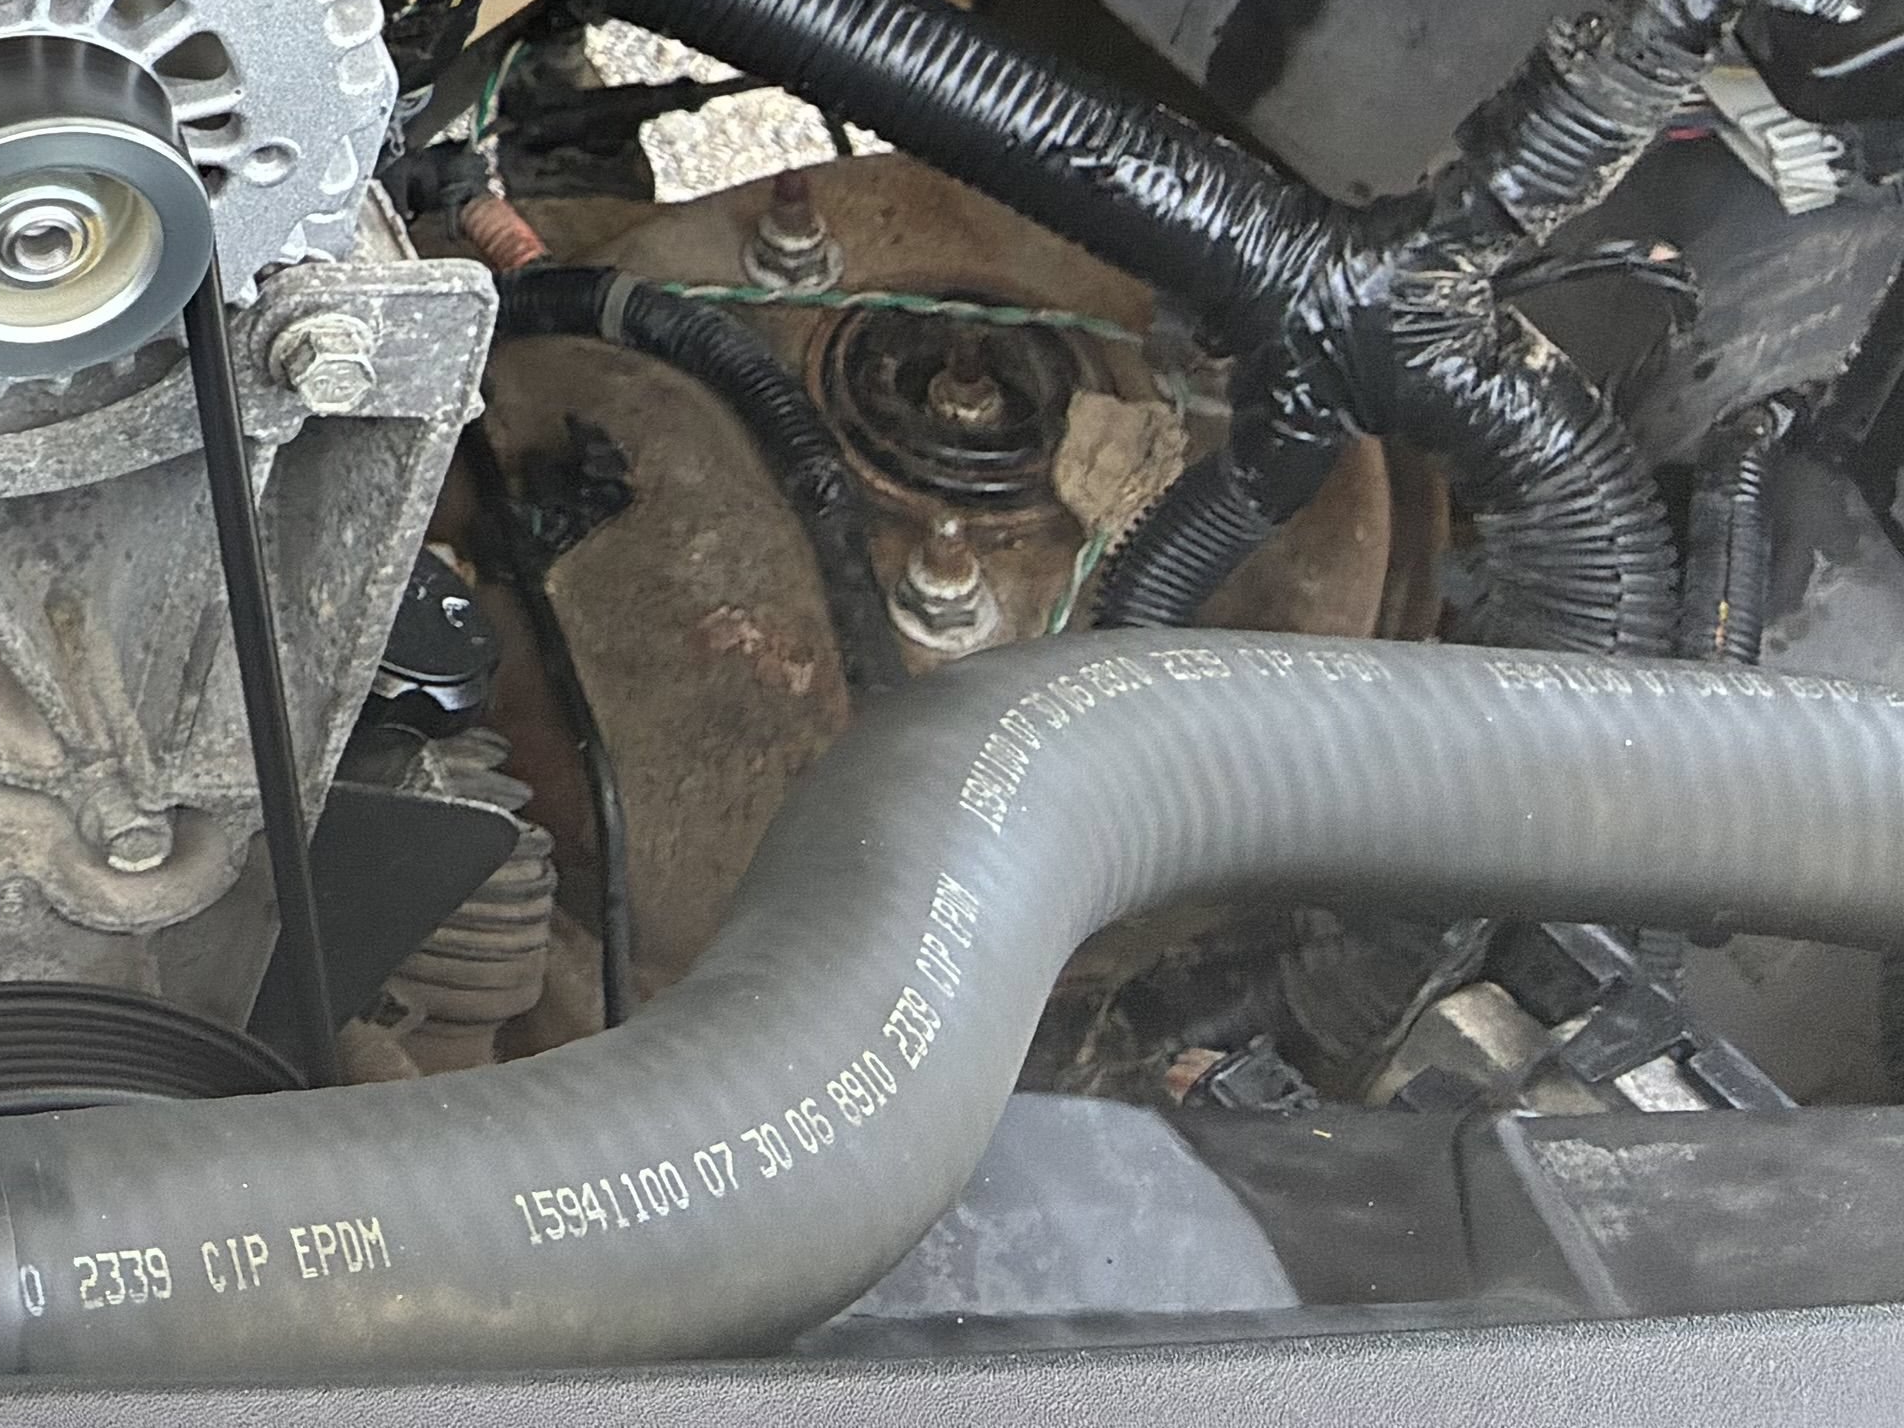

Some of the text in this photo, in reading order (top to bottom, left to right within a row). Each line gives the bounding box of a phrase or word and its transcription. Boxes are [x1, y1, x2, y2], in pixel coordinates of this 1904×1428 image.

[514, 872, 982, 1246] 15941100 07 30 06 8910 2339 CIP EPDM
[73, 1246, 174, 1310] 2339
[201, 1232, 270, 1294] CIP
[290, 1216, 391, 1280] EPDM
